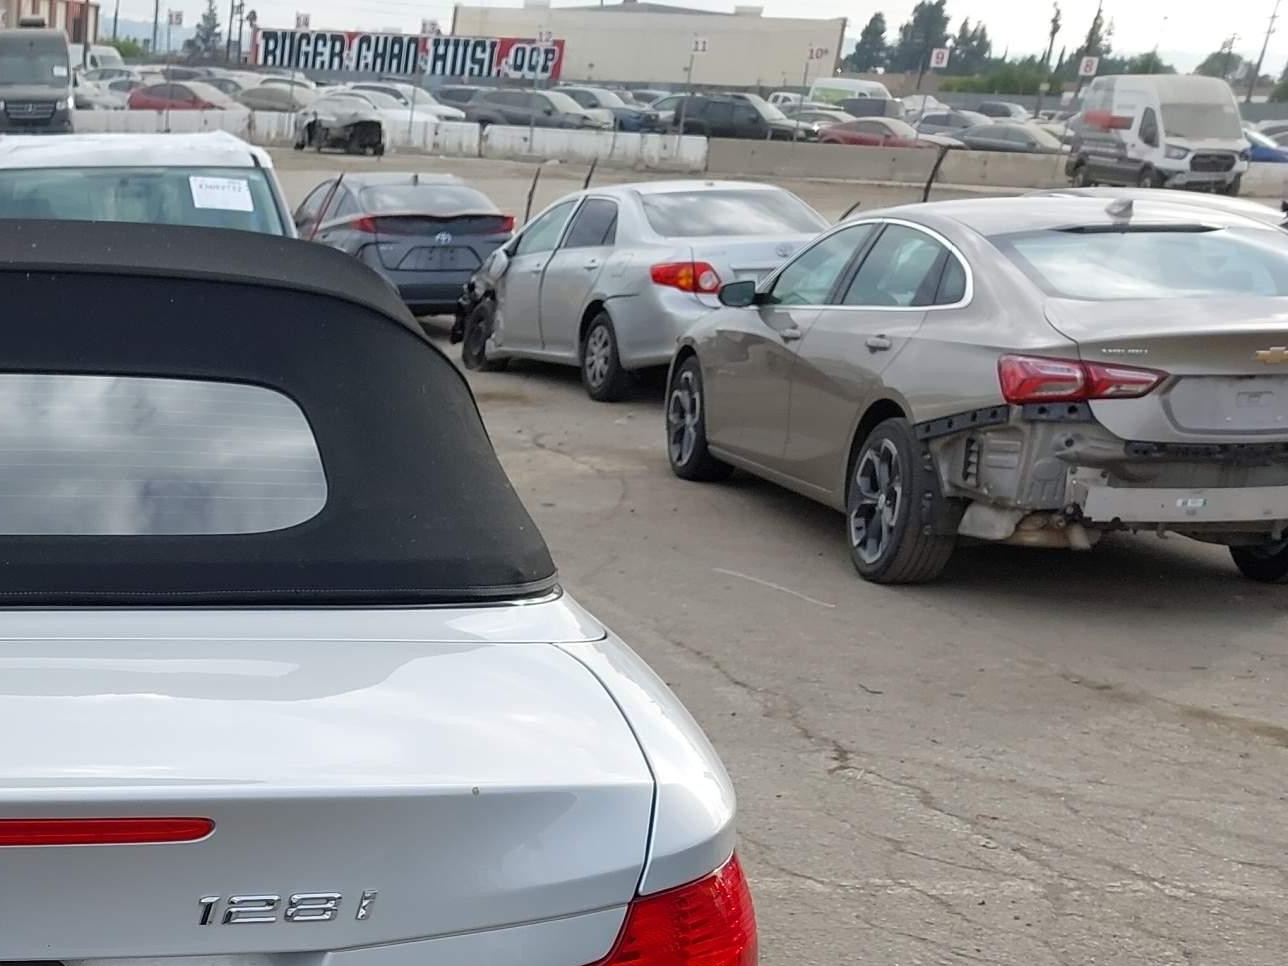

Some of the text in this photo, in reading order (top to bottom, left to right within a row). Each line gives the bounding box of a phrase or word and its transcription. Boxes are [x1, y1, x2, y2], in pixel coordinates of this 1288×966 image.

[693, 40, 707, 52] 11
[808, 48, 824, 60] 10
[934, 50, 945, 65] 9
[1082, 59, 1094, 73] 8
[199, 888, 379, 926] 128i
